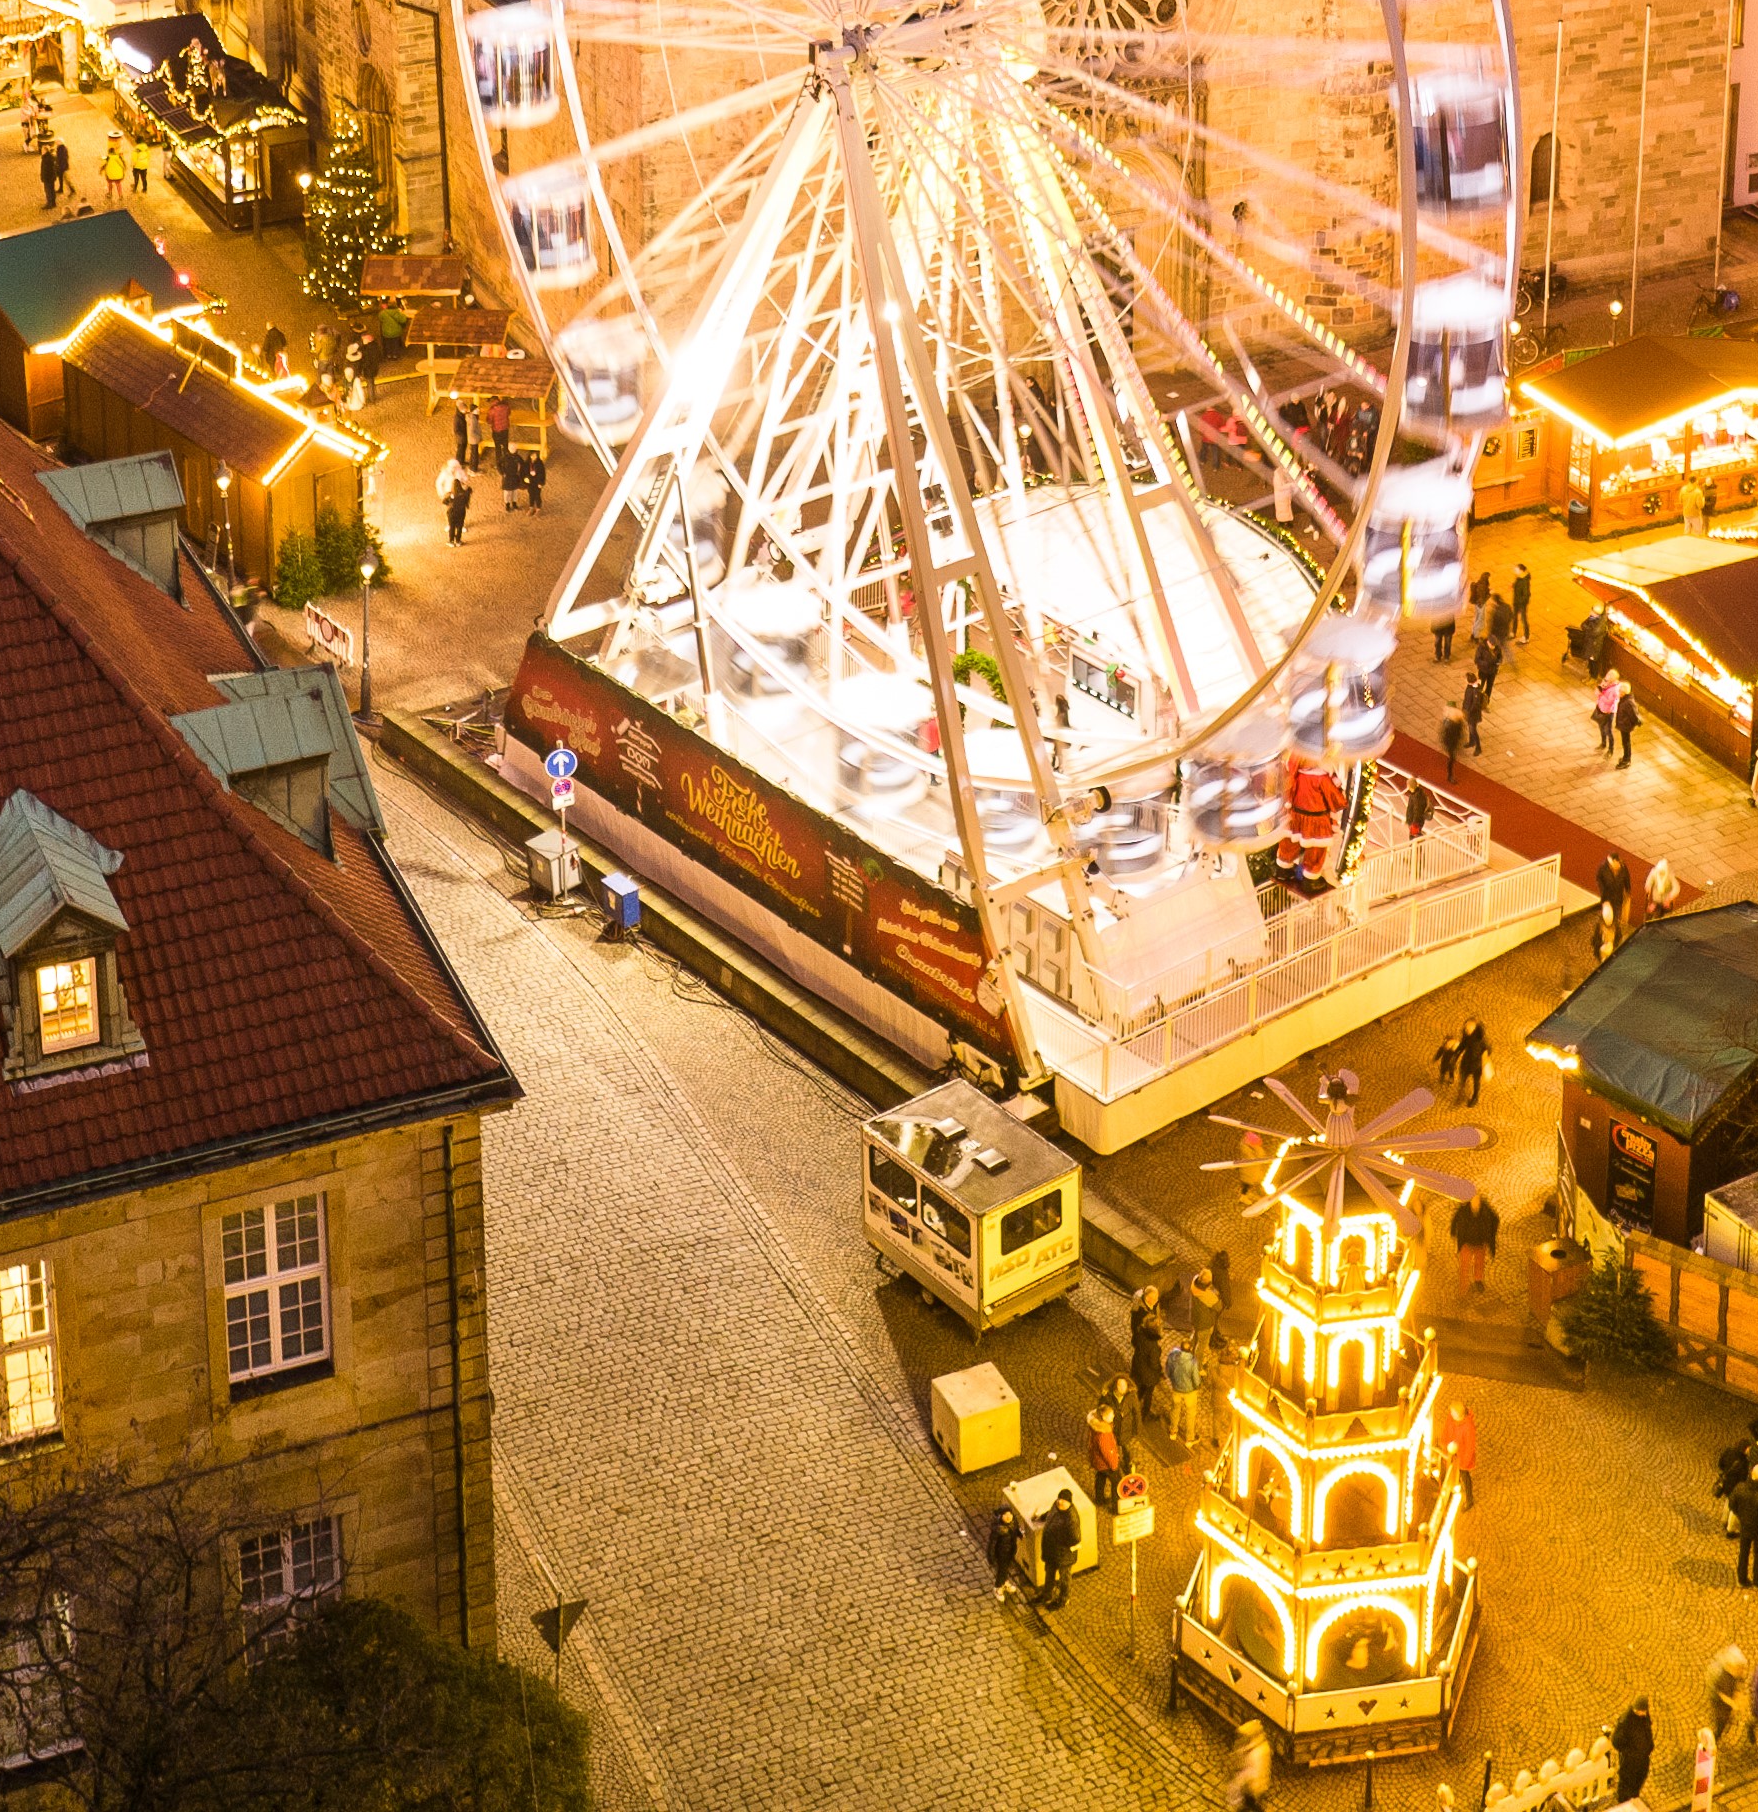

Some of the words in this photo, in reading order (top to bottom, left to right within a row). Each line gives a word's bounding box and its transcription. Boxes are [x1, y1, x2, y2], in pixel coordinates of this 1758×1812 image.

[680, 772, 801, 879] Weihnachten
[711, 764, 771, 832] Frohe
[763, 873, 823, 918] Cornelius
[896, 943, 976, 1003] Osnabrück
[1033, 1235, 1074, 1268] ATG
